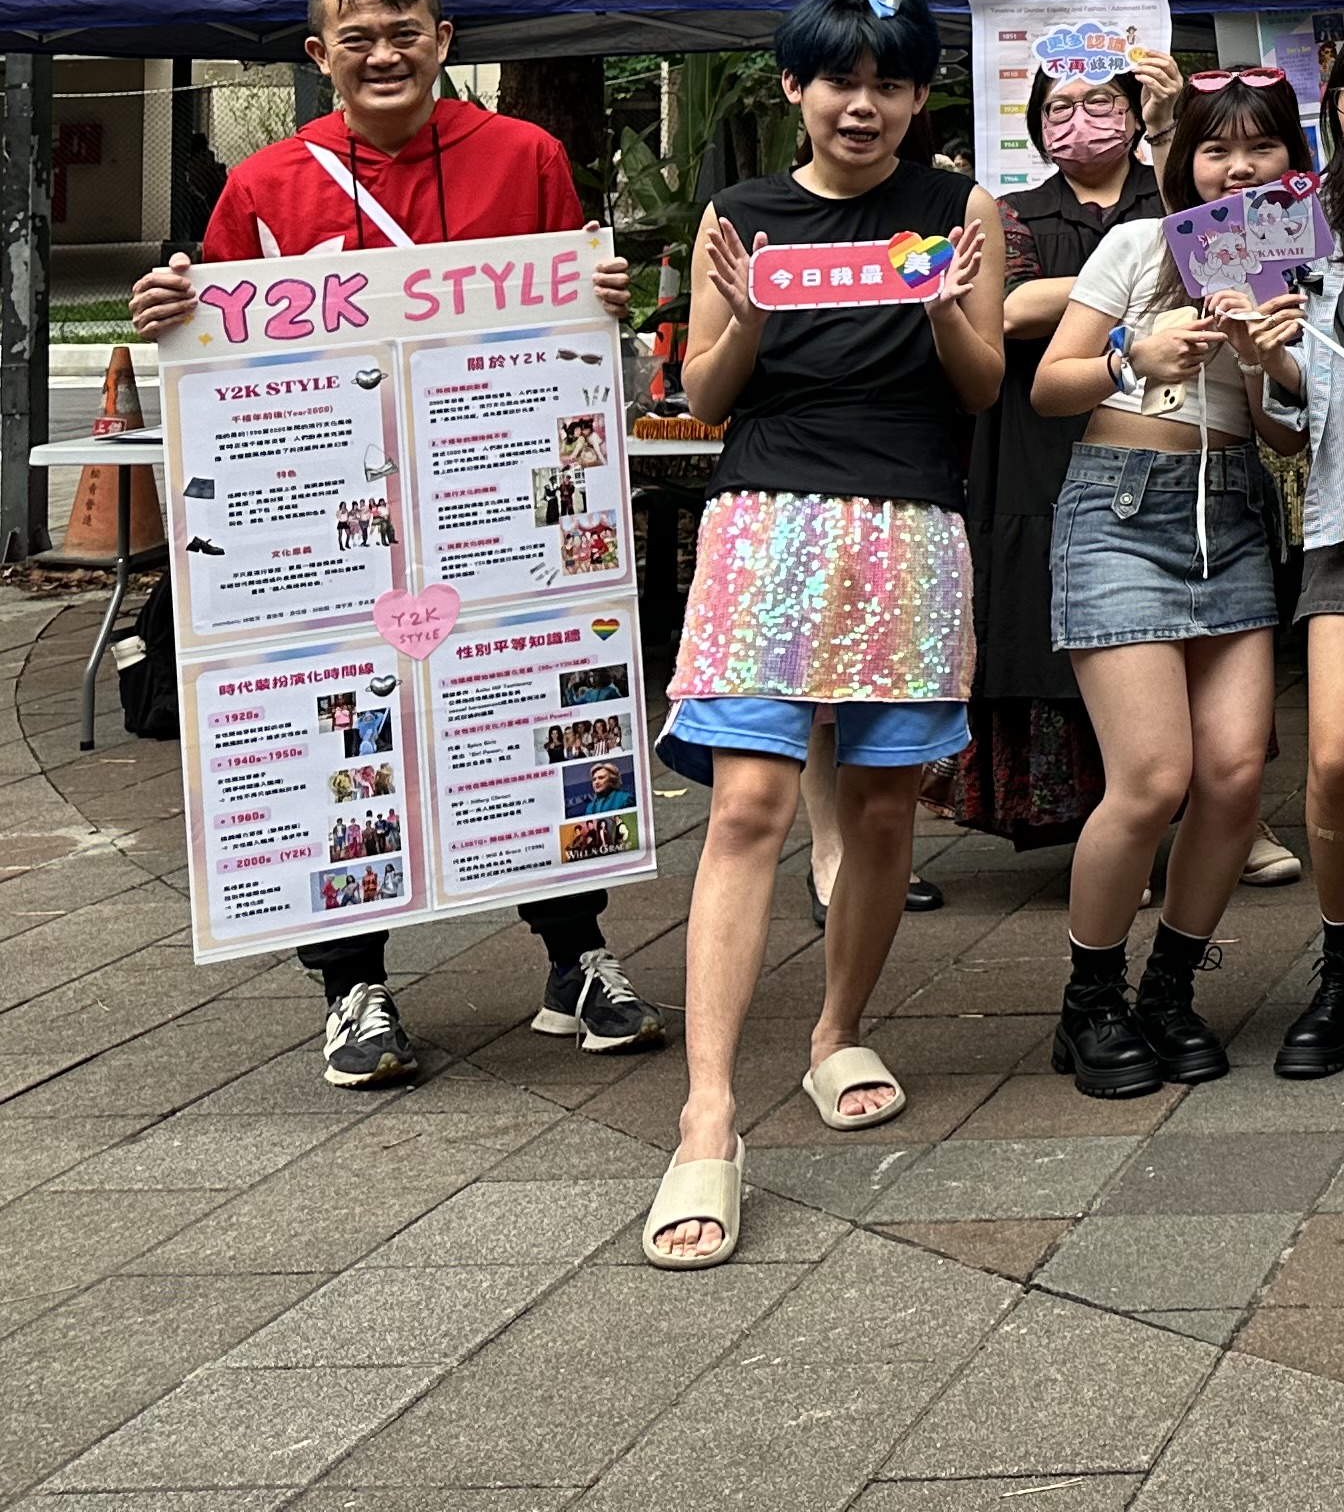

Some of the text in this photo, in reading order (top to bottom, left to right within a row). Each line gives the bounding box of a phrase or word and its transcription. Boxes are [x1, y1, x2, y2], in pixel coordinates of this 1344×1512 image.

[1046, 56, 1126, 73] 不再歧視
[1258, 246, 1304, 258] KAWAII
[769, 250, 932, 290] 今日我最美
[200, 251, 581, 344] Y2K STYLE
[467, 351, 547, 372] 關於Y2K
[214, 375, 341, 402] Y2K STYLE
[391, 607, 441, 627] Y2K
[400, 628, 440, 644] STYLE
[218, 662, 375, 697] 時代裝扮演化時間線
[279, 848, 312, 862] (Y2K)
